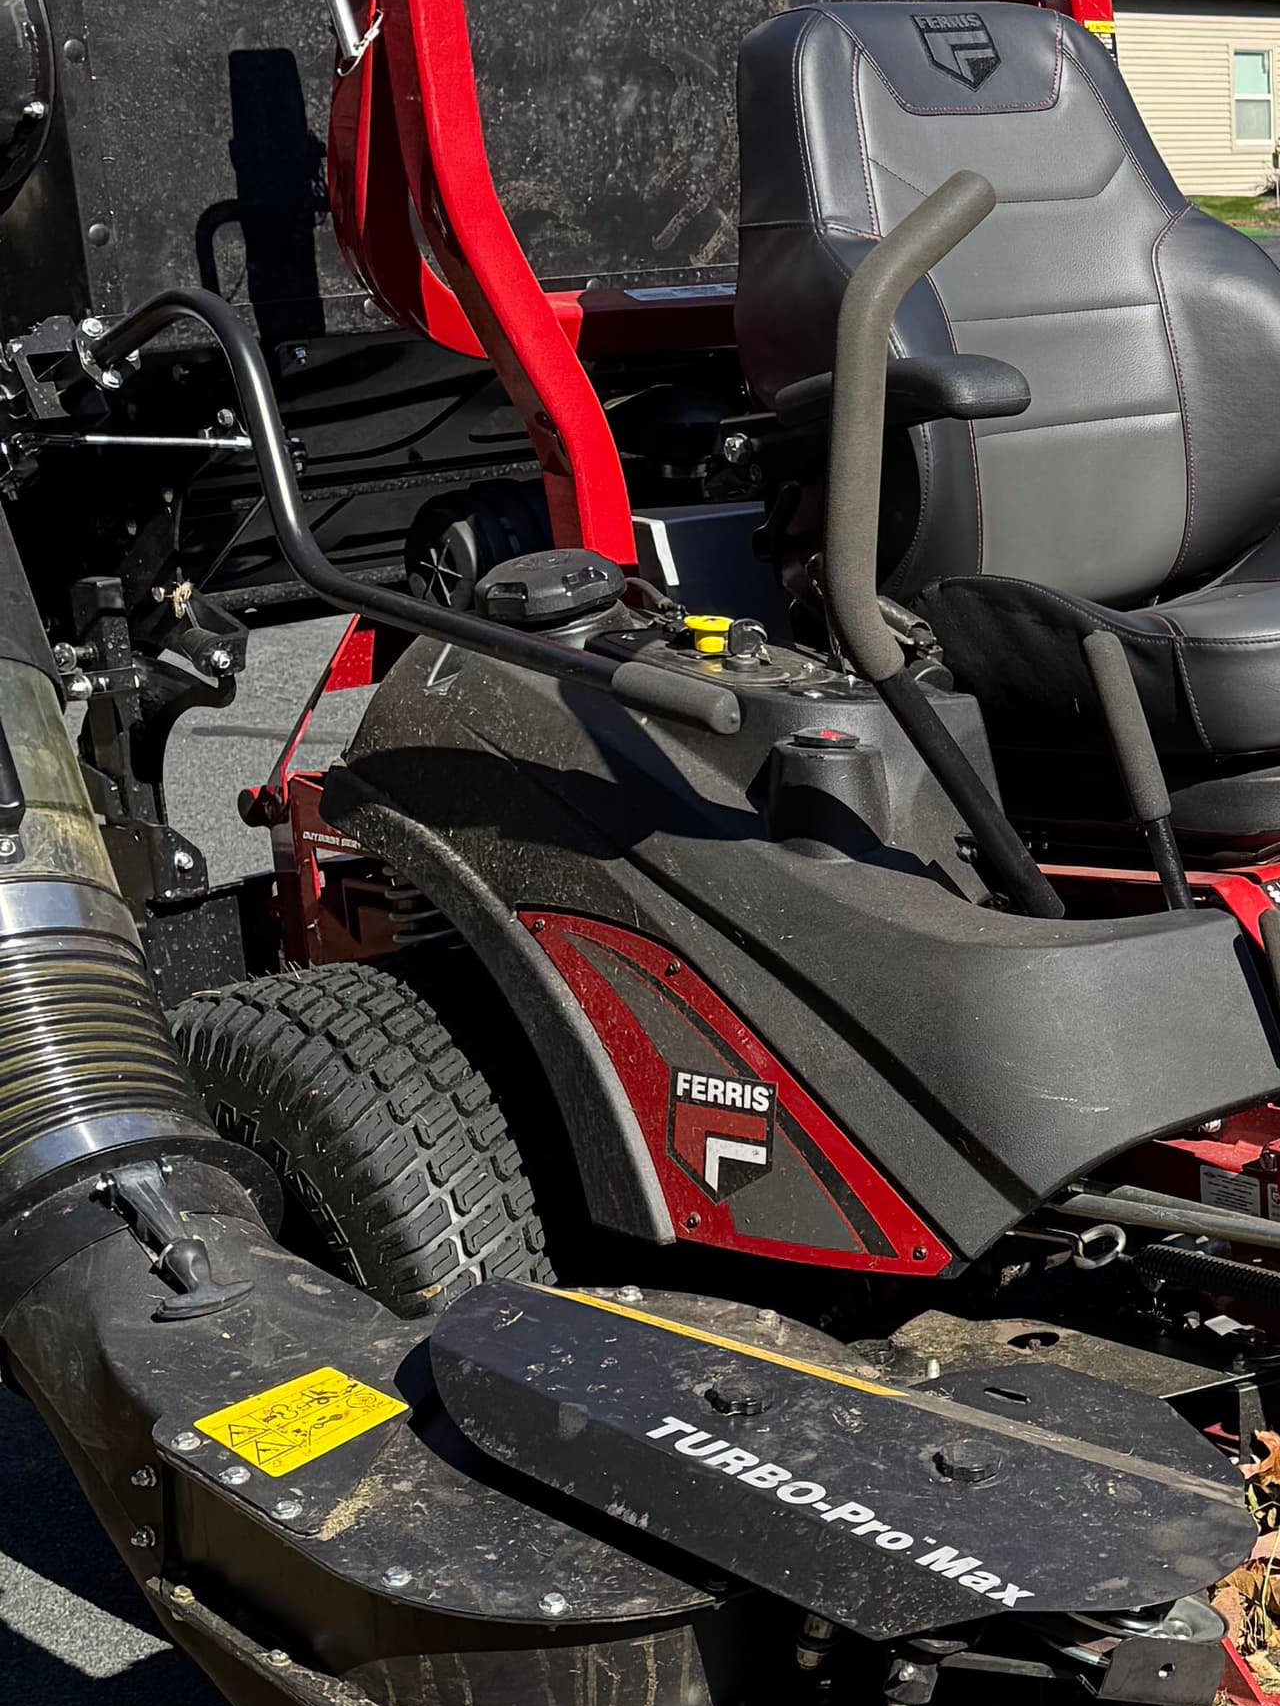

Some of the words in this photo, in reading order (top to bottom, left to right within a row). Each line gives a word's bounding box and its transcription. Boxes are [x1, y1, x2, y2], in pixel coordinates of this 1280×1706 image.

[913, 14, 982, 29] FERRIS
[676, 1072, 770, 1112] FERRIS
[646, 1416, 914, 1551] TURBO-Pro
[914, 1545, 1036, 1607] Max
